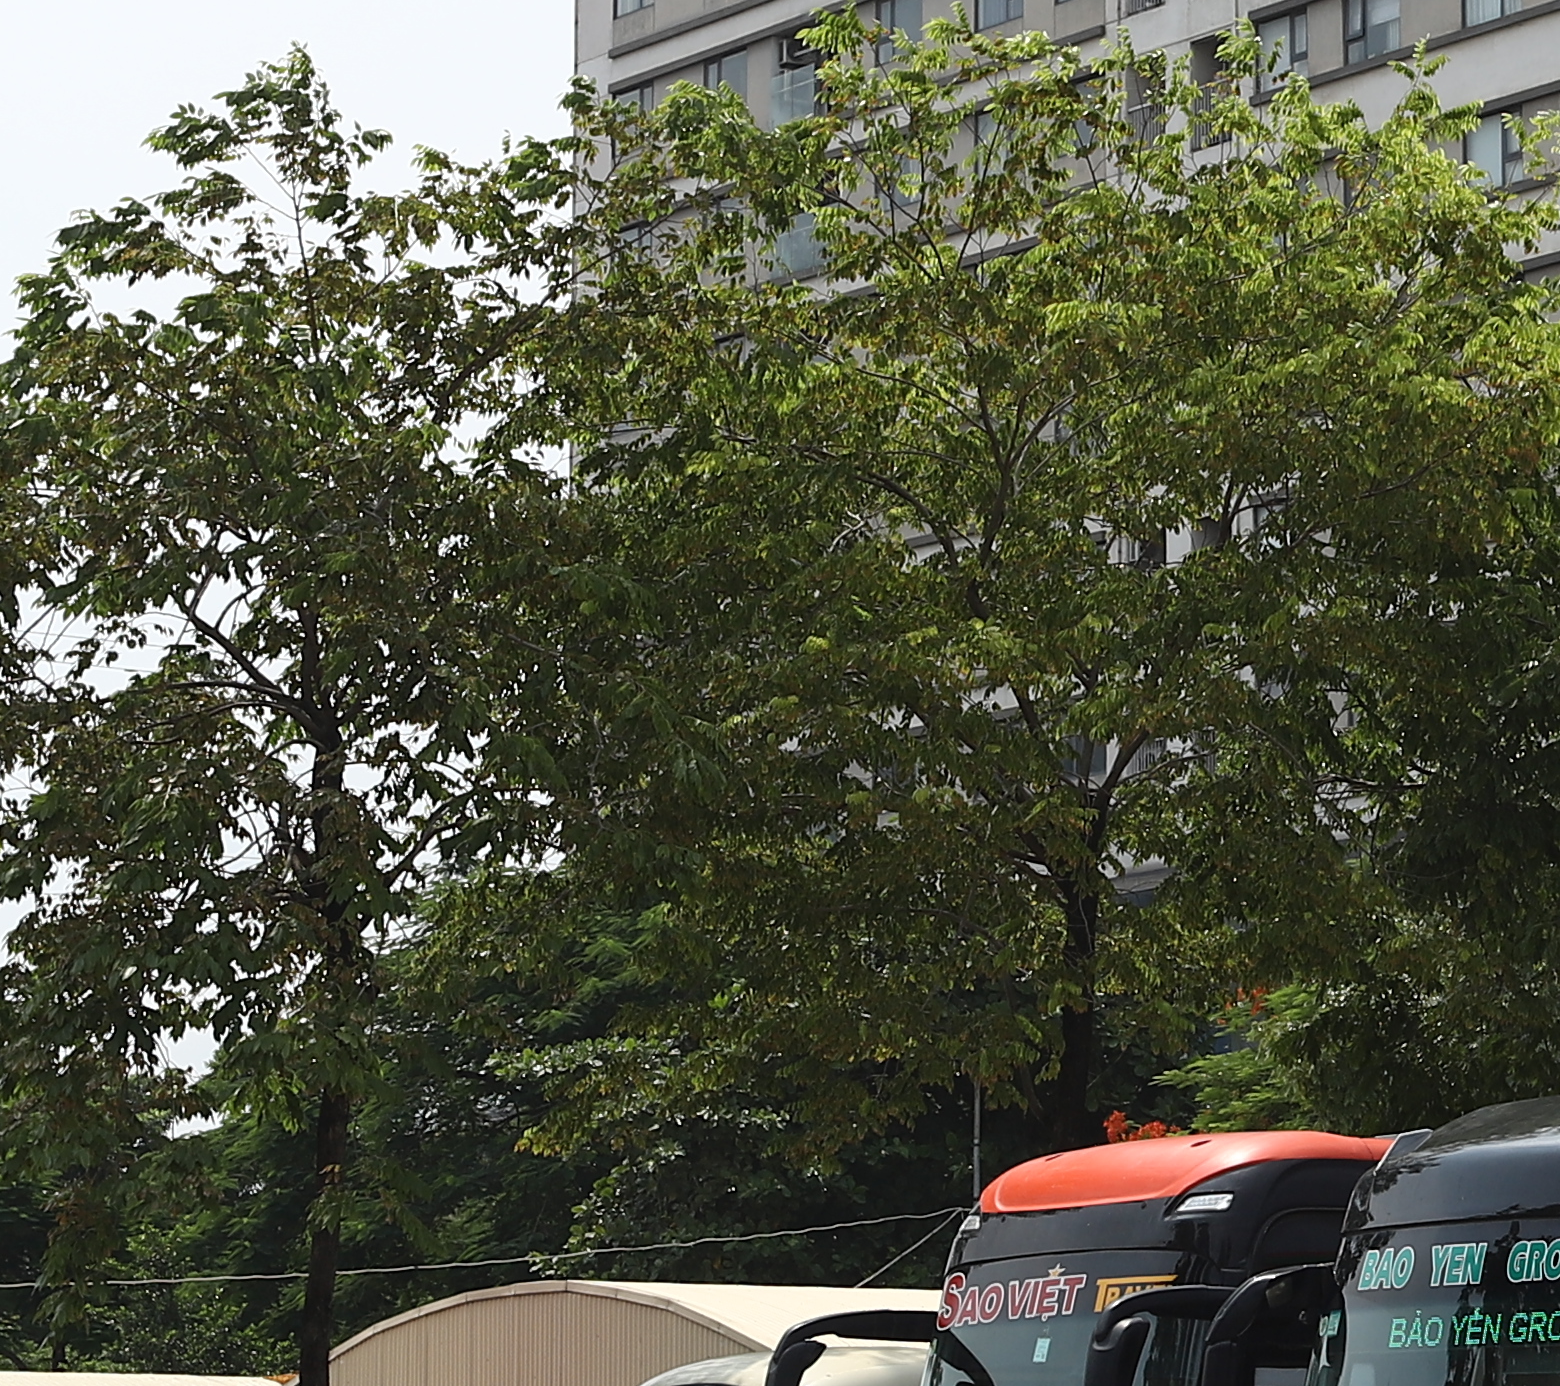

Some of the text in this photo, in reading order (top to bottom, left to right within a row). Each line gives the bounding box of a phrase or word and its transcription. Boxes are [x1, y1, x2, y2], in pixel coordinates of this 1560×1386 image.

[1357, 1245, 1416, 1291] BAO
[1430, 1242, 1488, 1286] YEN
[936, 1272, 1004, 1331] SAO
